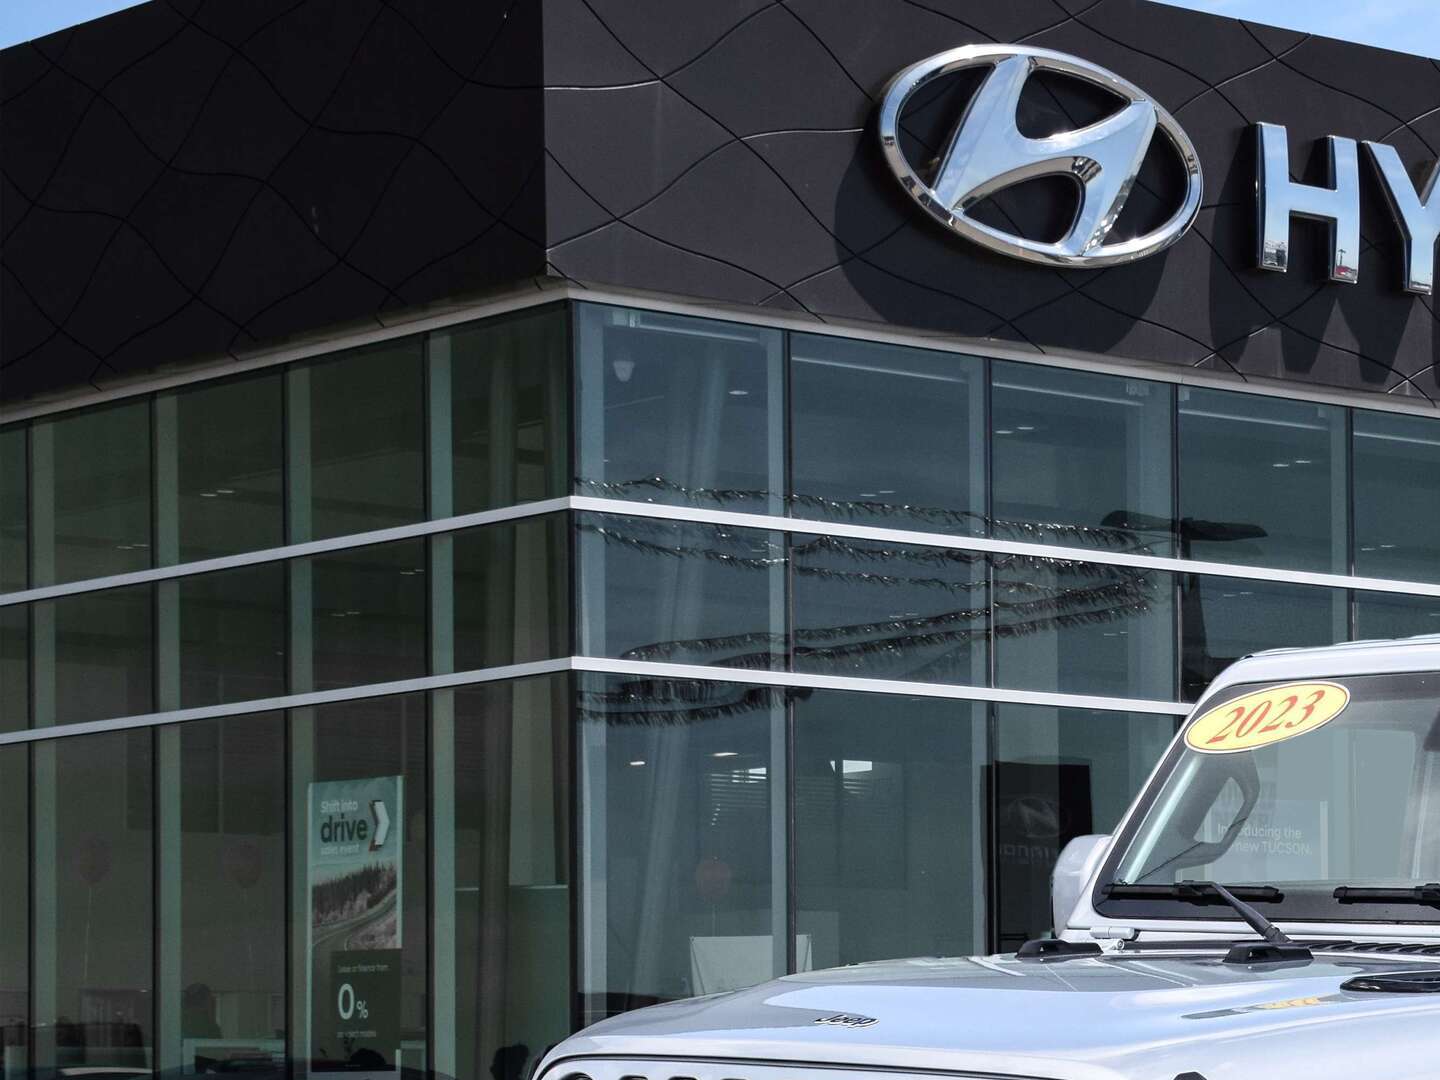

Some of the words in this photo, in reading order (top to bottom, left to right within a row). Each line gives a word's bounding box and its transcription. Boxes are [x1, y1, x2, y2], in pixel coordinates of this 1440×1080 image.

[1204, 689, 1326, 745] 2023
[320, 812, 368, 843] drive
[1284, 825, 1302, 839] the
